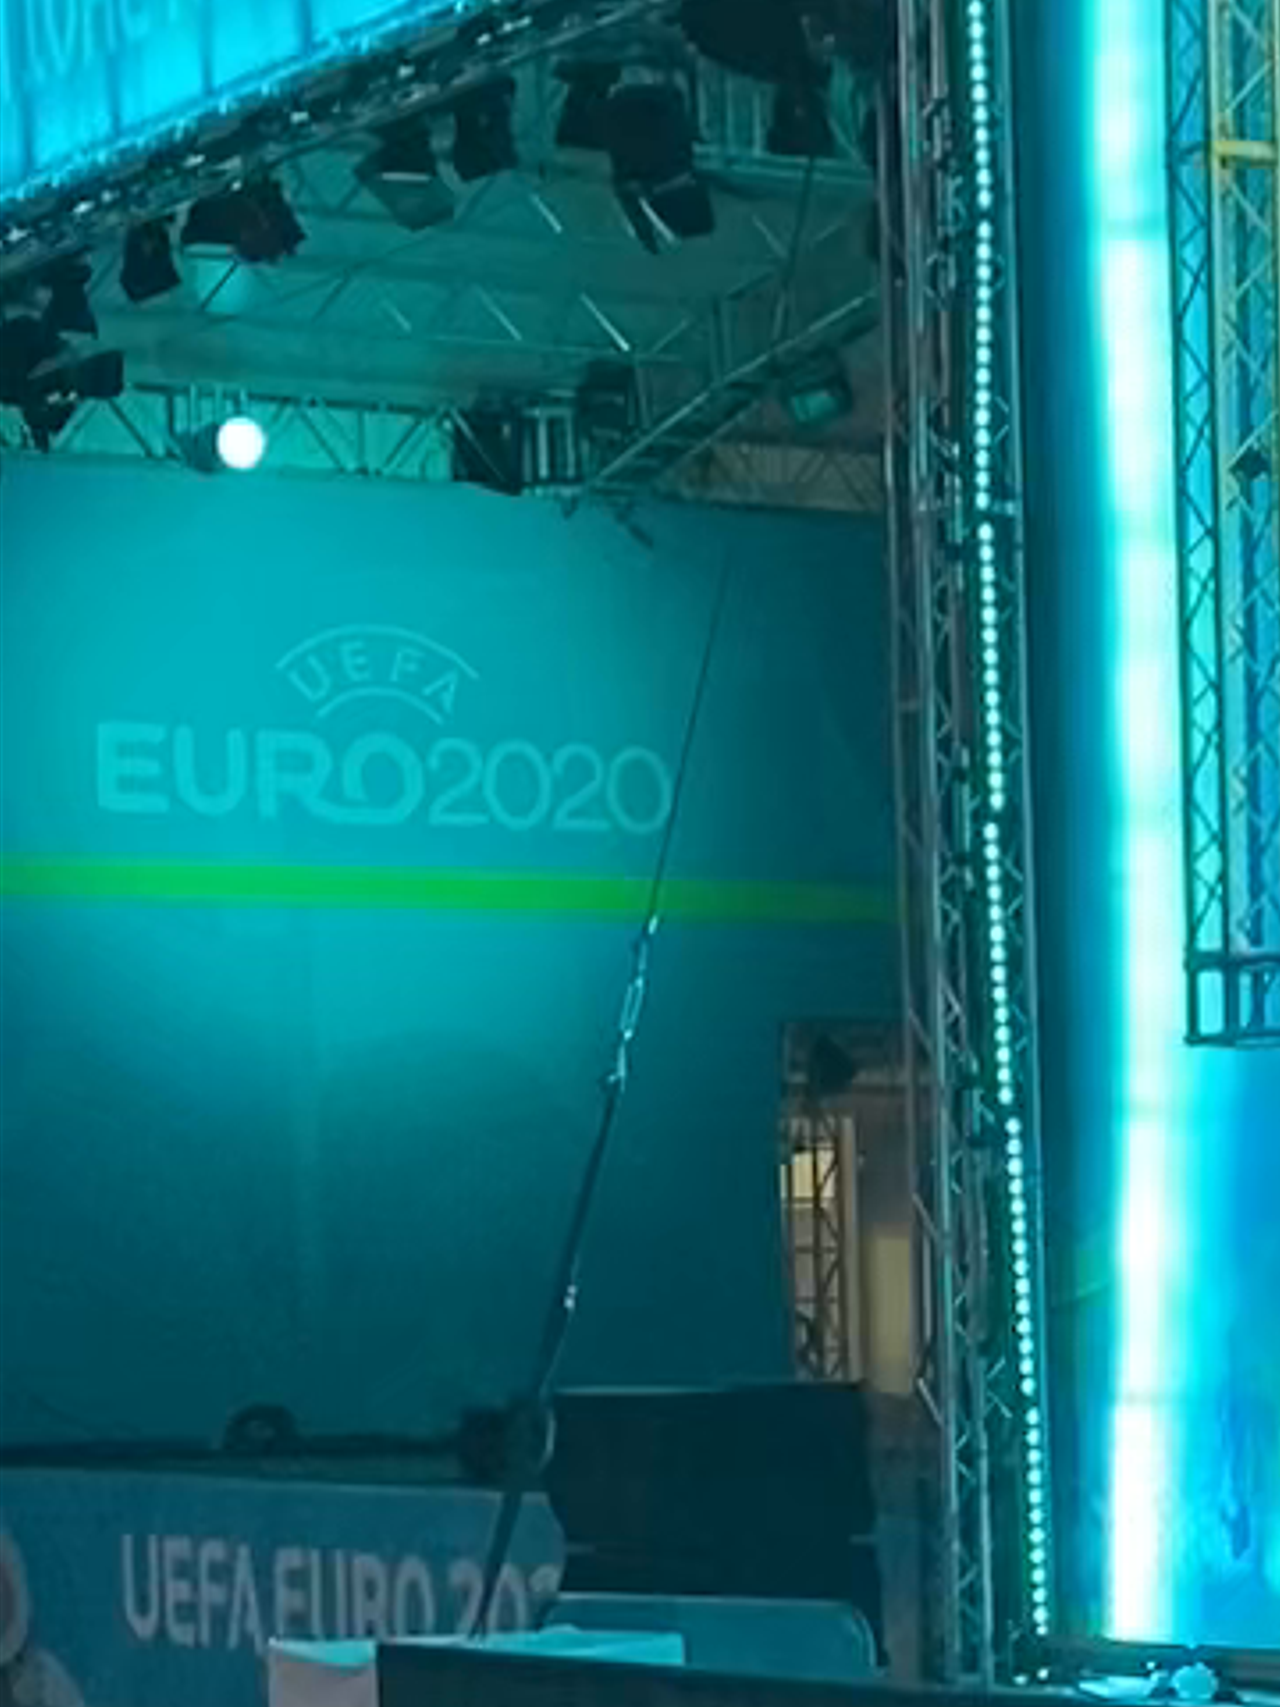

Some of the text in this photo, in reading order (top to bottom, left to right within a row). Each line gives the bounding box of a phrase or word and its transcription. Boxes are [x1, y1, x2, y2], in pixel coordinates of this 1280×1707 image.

[287, 638, 462, 715] UEFA
[95, 720, 673, 836] EURO2020
[120, 1533, 264, 1658] UEFA
[270, 1545, 437, 1639] EURO
